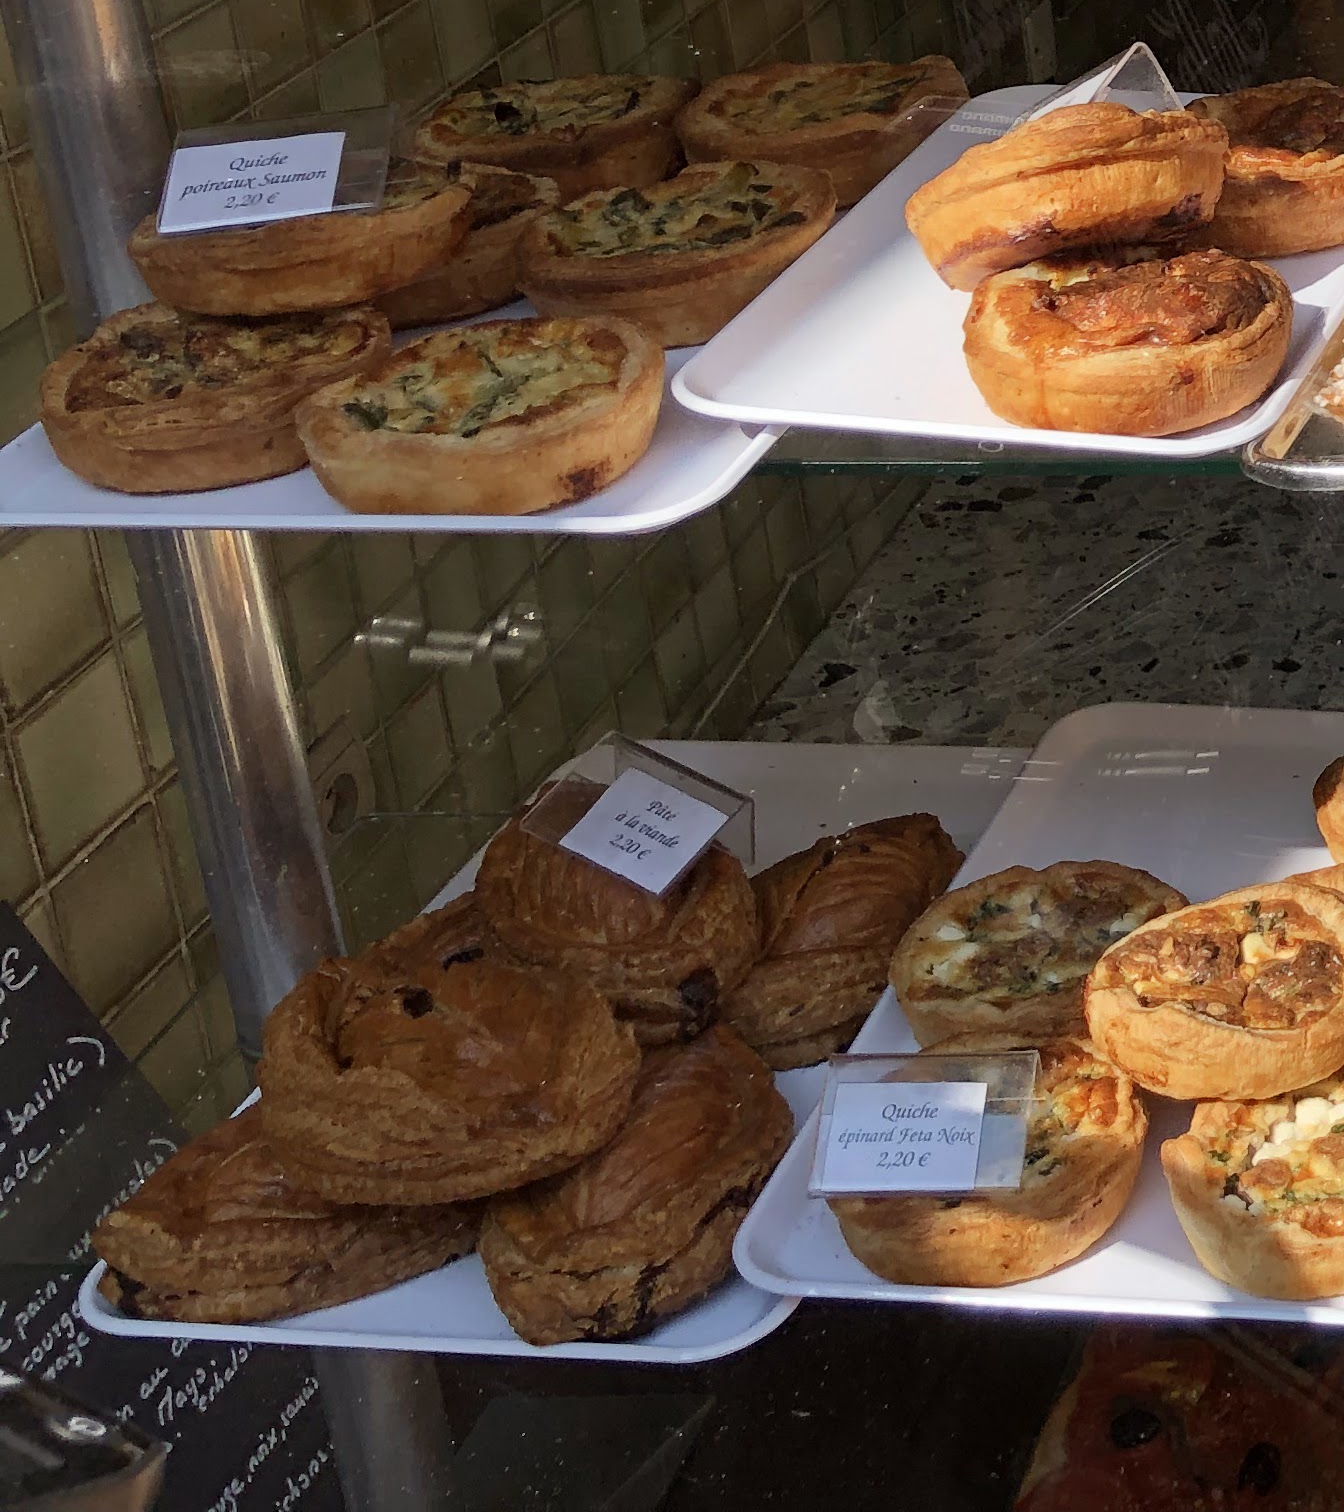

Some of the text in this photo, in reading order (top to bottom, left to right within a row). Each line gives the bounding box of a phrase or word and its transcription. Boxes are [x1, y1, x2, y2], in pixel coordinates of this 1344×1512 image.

[228, 152, 289, 172] Quiche
[179, 169, 327, 201] poireaux Saumon
[223, 191, 281, 210] 2,20 €
[646, 799, 679, 822] Pâté
[615, 810, 682, 849] à la viande
[608, 834, 652, 861] 2,20 €
[881, 1100, 939, 1123] Quiche
[838, 1125, 975, 1150] épinard Feta Noix
[875, 1151, 931, 1170] 2,20 €
